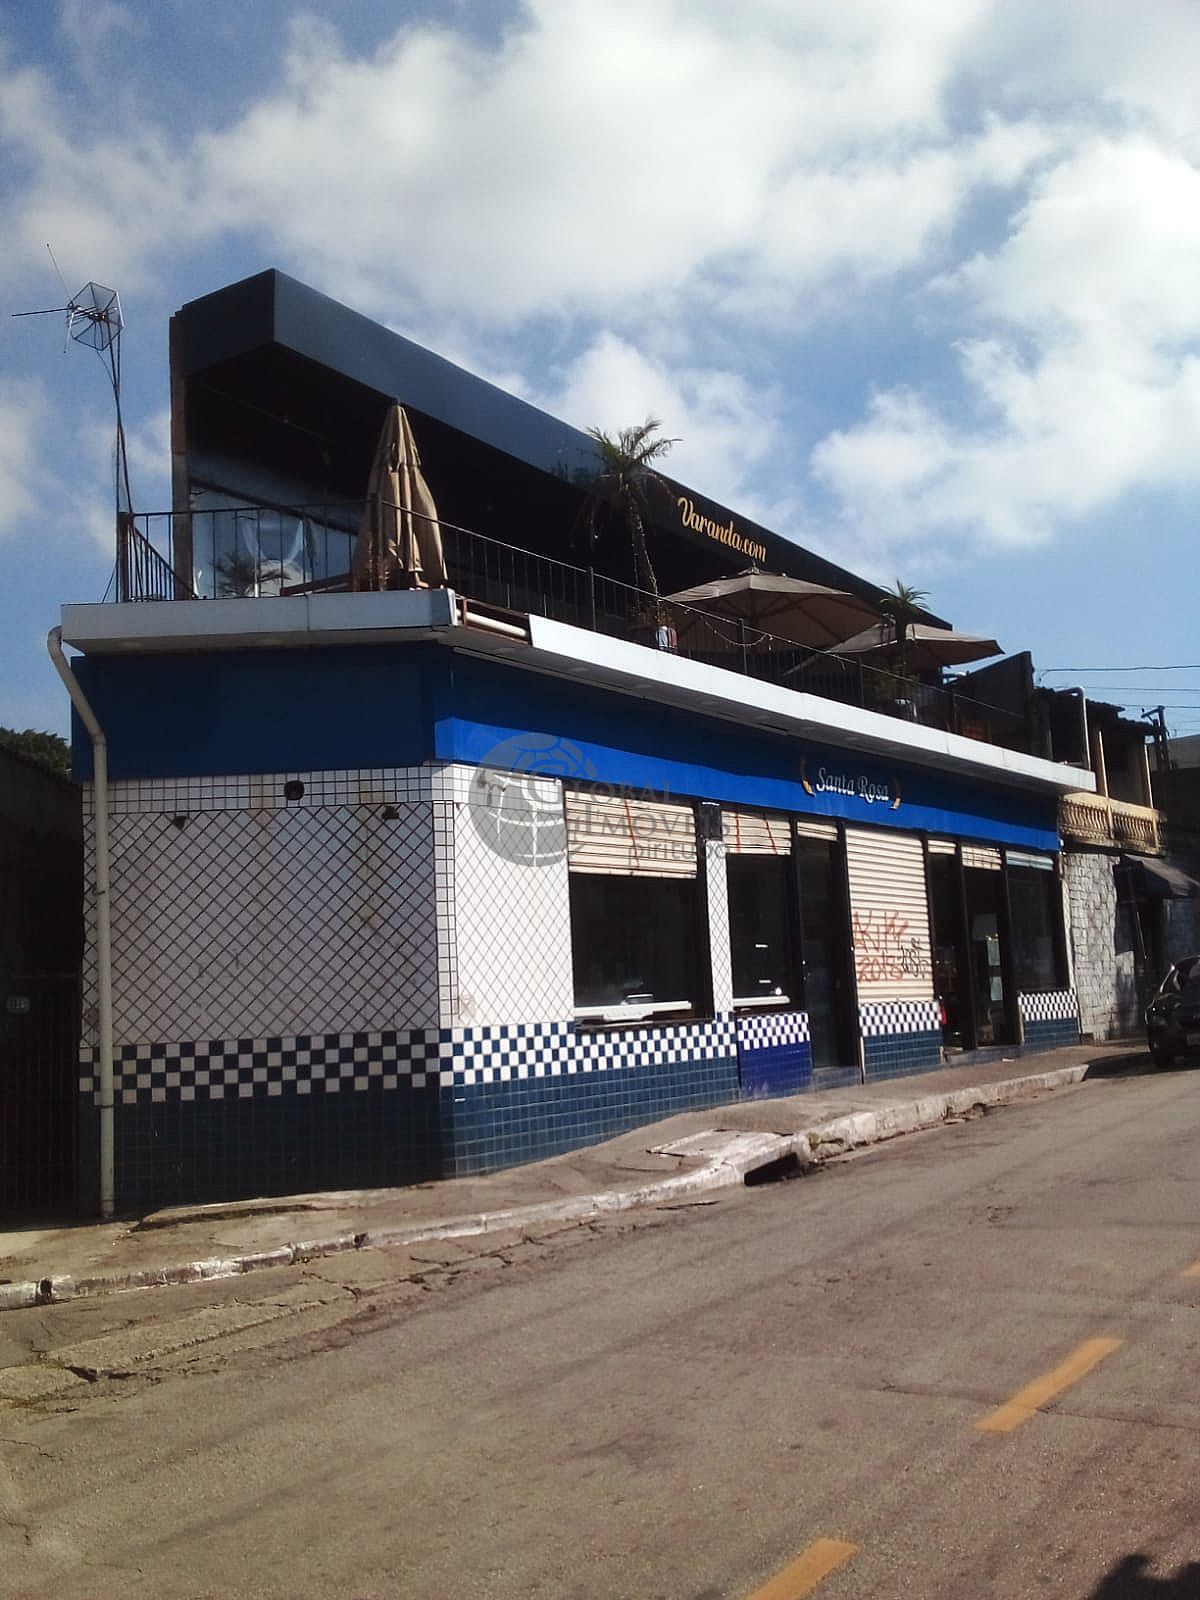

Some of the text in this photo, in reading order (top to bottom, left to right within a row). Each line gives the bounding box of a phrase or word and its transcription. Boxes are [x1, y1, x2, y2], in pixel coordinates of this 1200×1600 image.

[677, 497, 767, 563] Varanda.com
[815, 767, 890, 804] Santa Rosa
